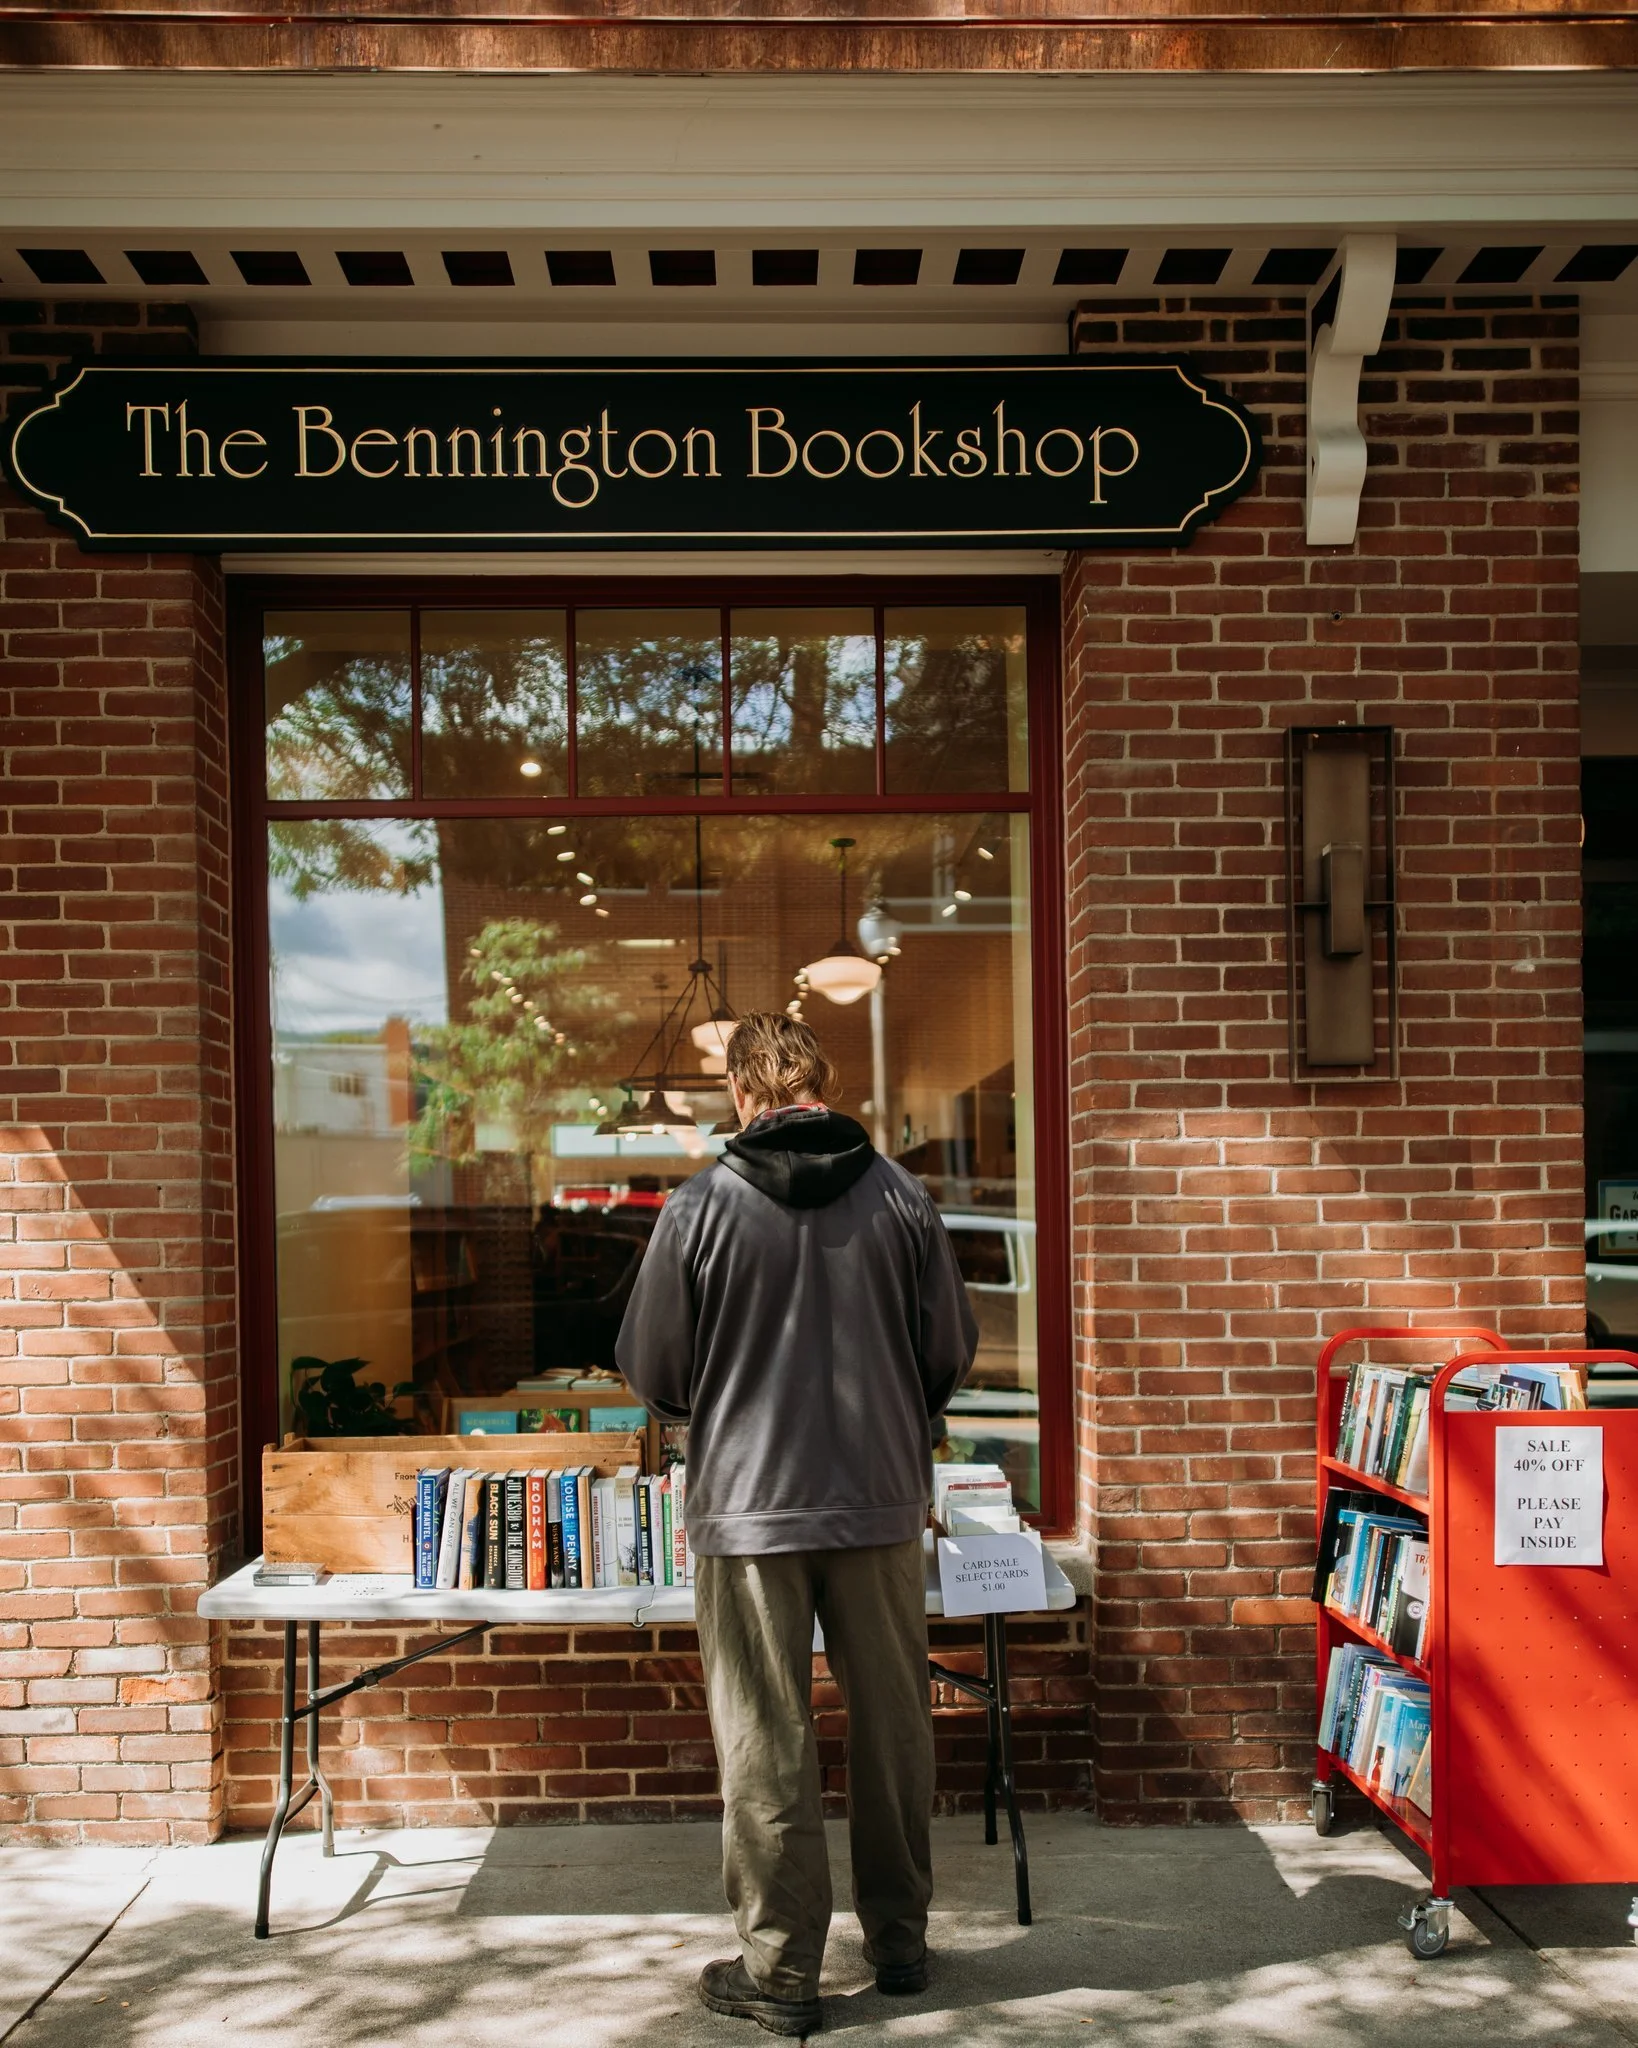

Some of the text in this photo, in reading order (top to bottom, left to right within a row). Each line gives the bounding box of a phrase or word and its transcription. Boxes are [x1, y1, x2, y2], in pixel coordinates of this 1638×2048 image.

[126, 399, 1139, 509] The Bennington Bookshop
[1527, 1439, 1571, 1453] SALE
[1513, 1458, 1585, 1473] 40% OFF
[506, 1479, 522, 1491] JO
[423, 1483, 431, 1539] HILARY MANTEL
[489, 1483, 499, 1540] BLACK SUN
[564, 1480, 575, 1519] LOUISE
[1517, 1497, 1582, 1510] PLEASE
[446, 1483, 460, 1548] ALL WE CAN SAVE
[531, 1481, 542, 1550] RODHAM
[1533, 1516, 1564, 1530] PAY
[566, 1534, 577, 1570] PENNY
[674, 1529, 685, 1567] SHE SAID
[1520, 1535, 1577, 1549] INSIDE
[508, 1531, 523, 1589] THE KINGDOM
[962, 1558, 1020, 1570] CARD SALE
[955, 1569, 1029, 1583] SELECT CARDS
[982, 1583, 1006, 1592] $1.00
